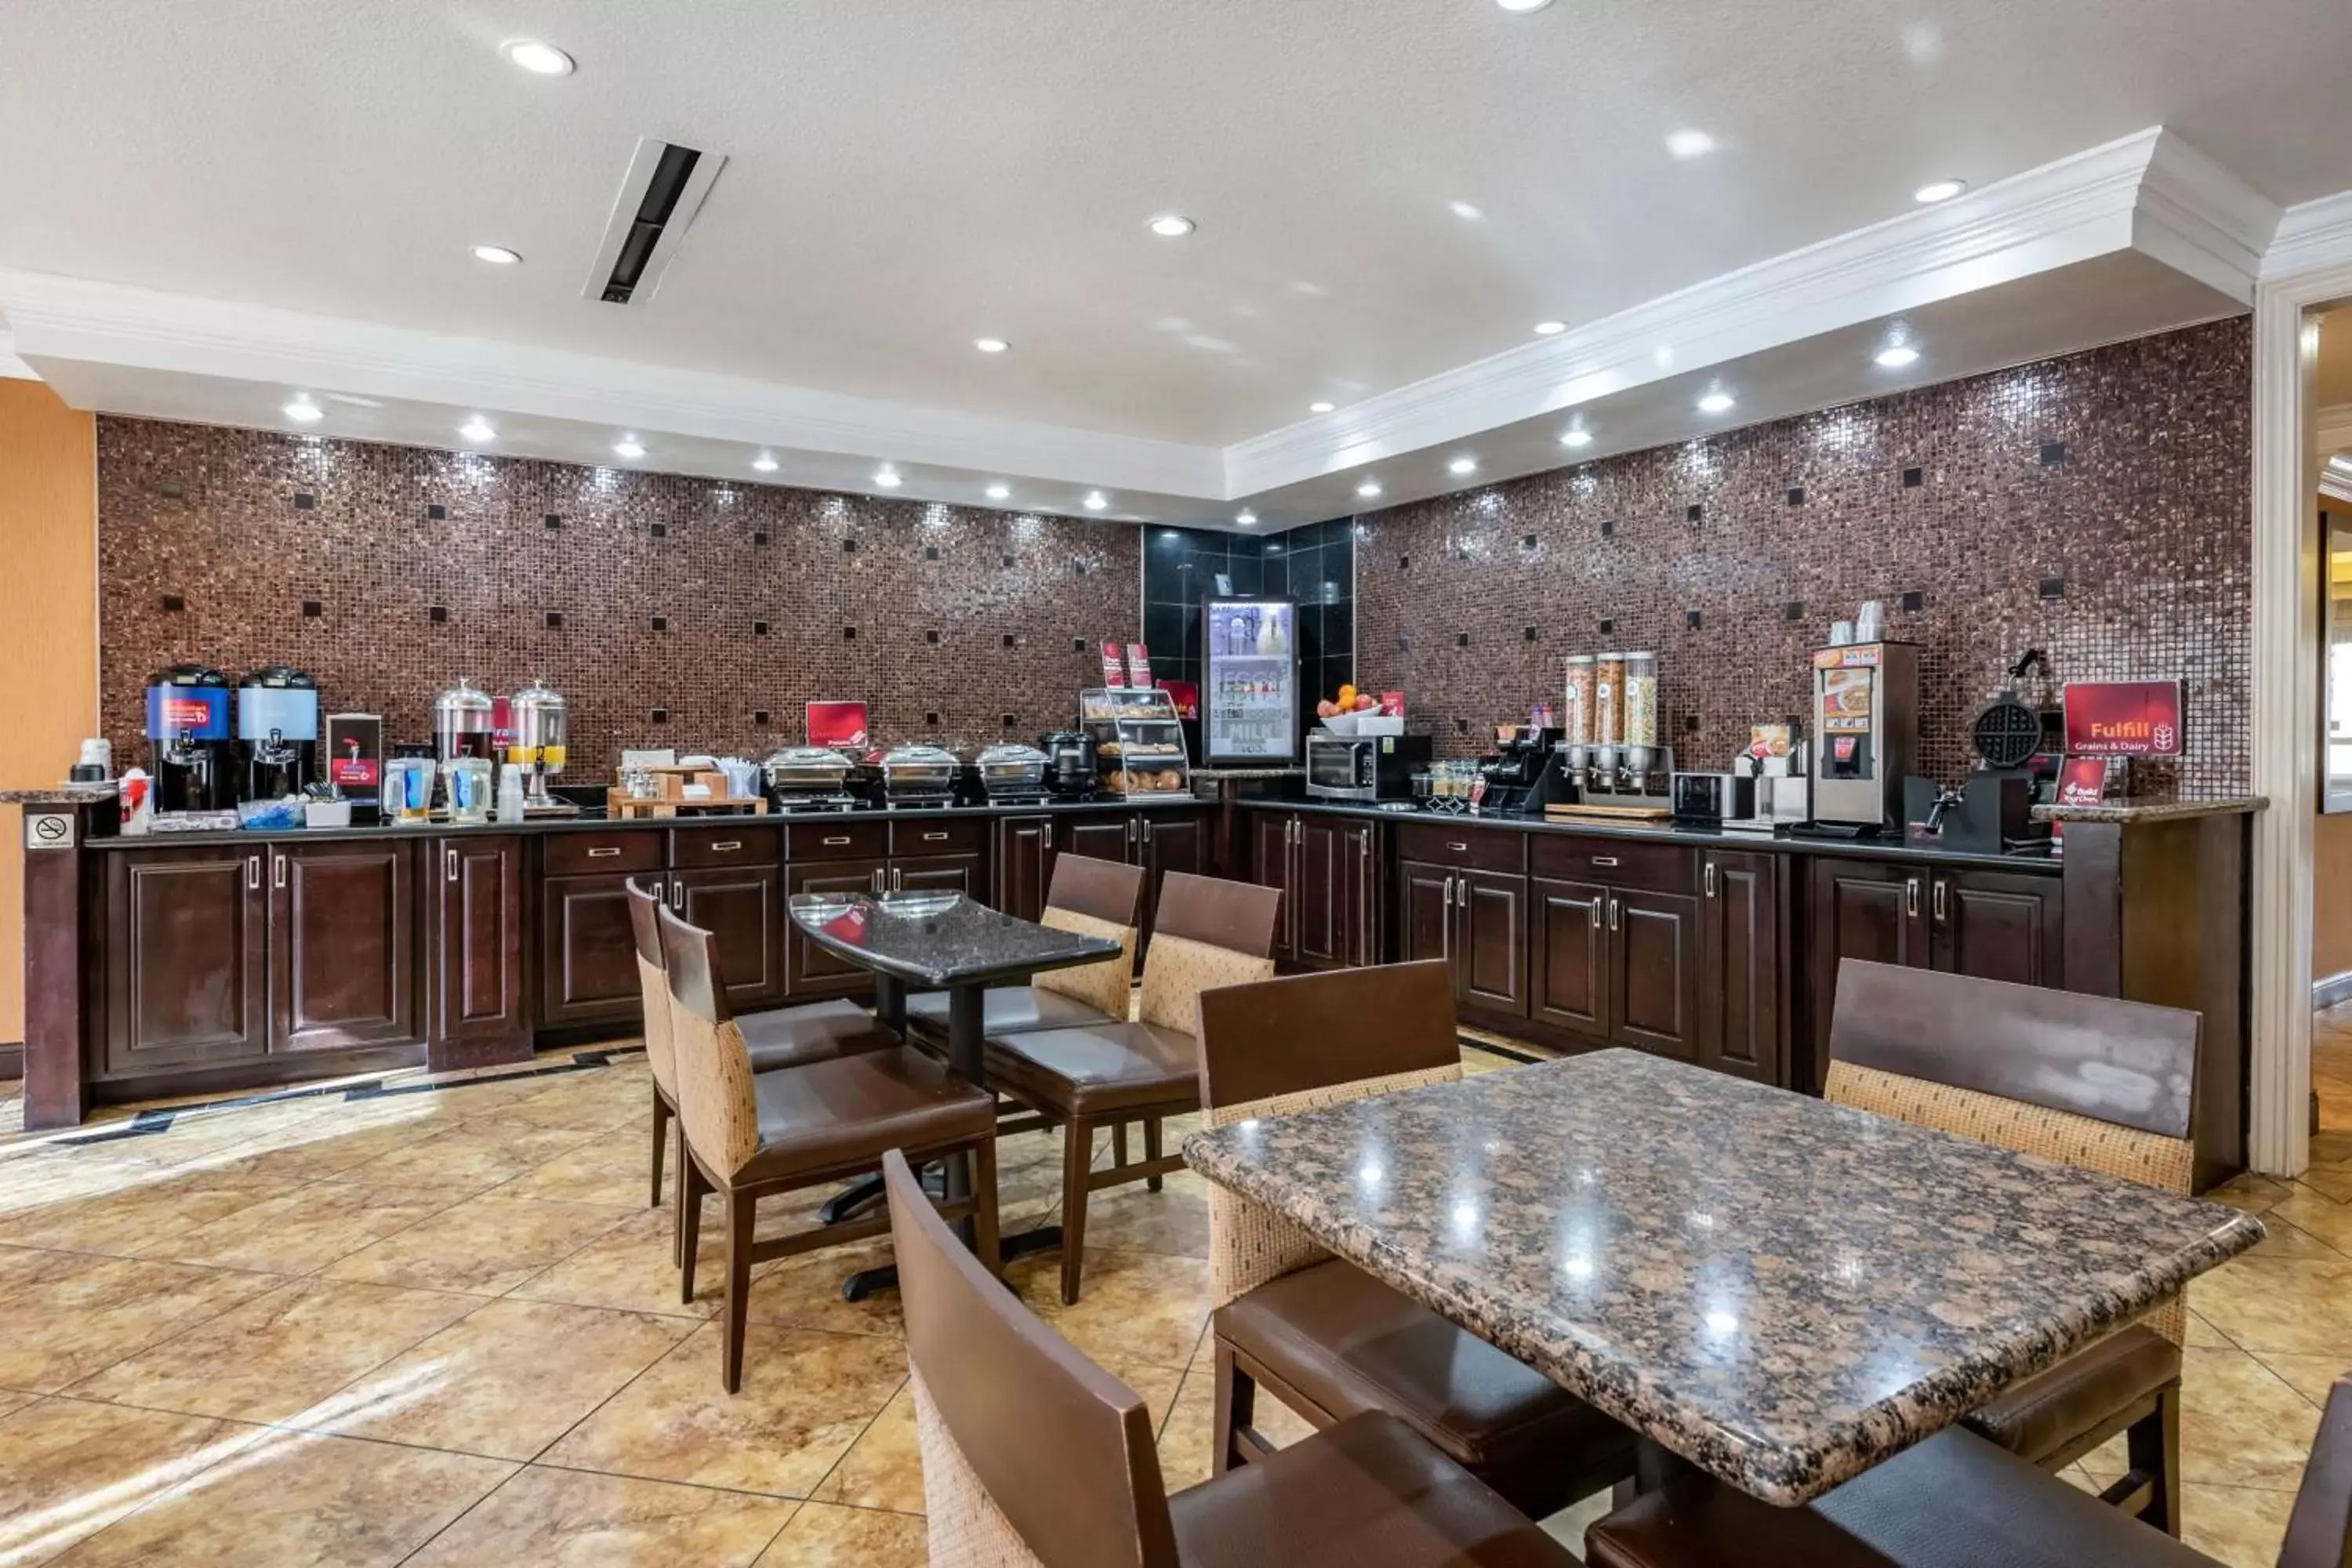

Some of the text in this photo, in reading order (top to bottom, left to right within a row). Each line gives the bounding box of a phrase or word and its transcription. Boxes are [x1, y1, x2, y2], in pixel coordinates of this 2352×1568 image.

[2091, 722, 2149, 738] Fulfill
[2074, 742, 2149, 752] Grains & Dairy
